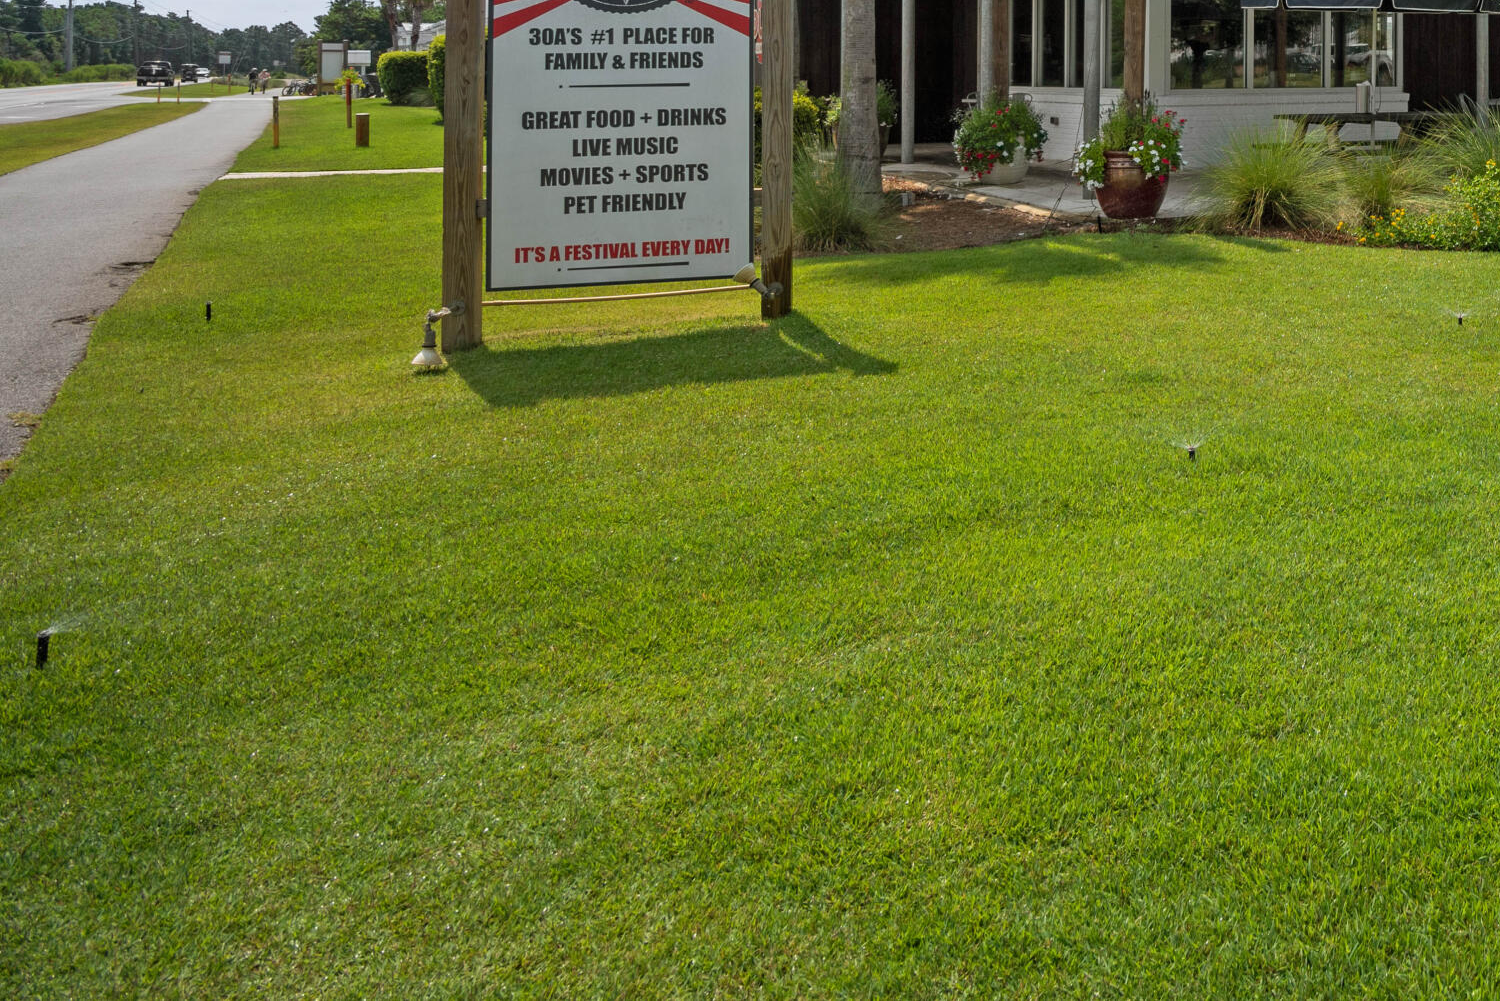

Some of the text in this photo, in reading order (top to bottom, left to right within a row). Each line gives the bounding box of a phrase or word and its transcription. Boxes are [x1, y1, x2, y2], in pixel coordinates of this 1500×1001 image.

[528, 27, 715, 46] 30A'S #1 PLACE FOR
[544, 51, 704, 70] FAMILY & FRIENDS
[521, 107, 727, 130] GREAT FOOD + DRINKS
[571, 136, 679, 157] LIVE MUSIC
[540, 163, 709, 187] MOVIES + SPORTS
[563, 192, 687, 215] PET FRIENDLY
[514, 237, 730, 264] IT'S A FESTIVAL EVERY DAY!
